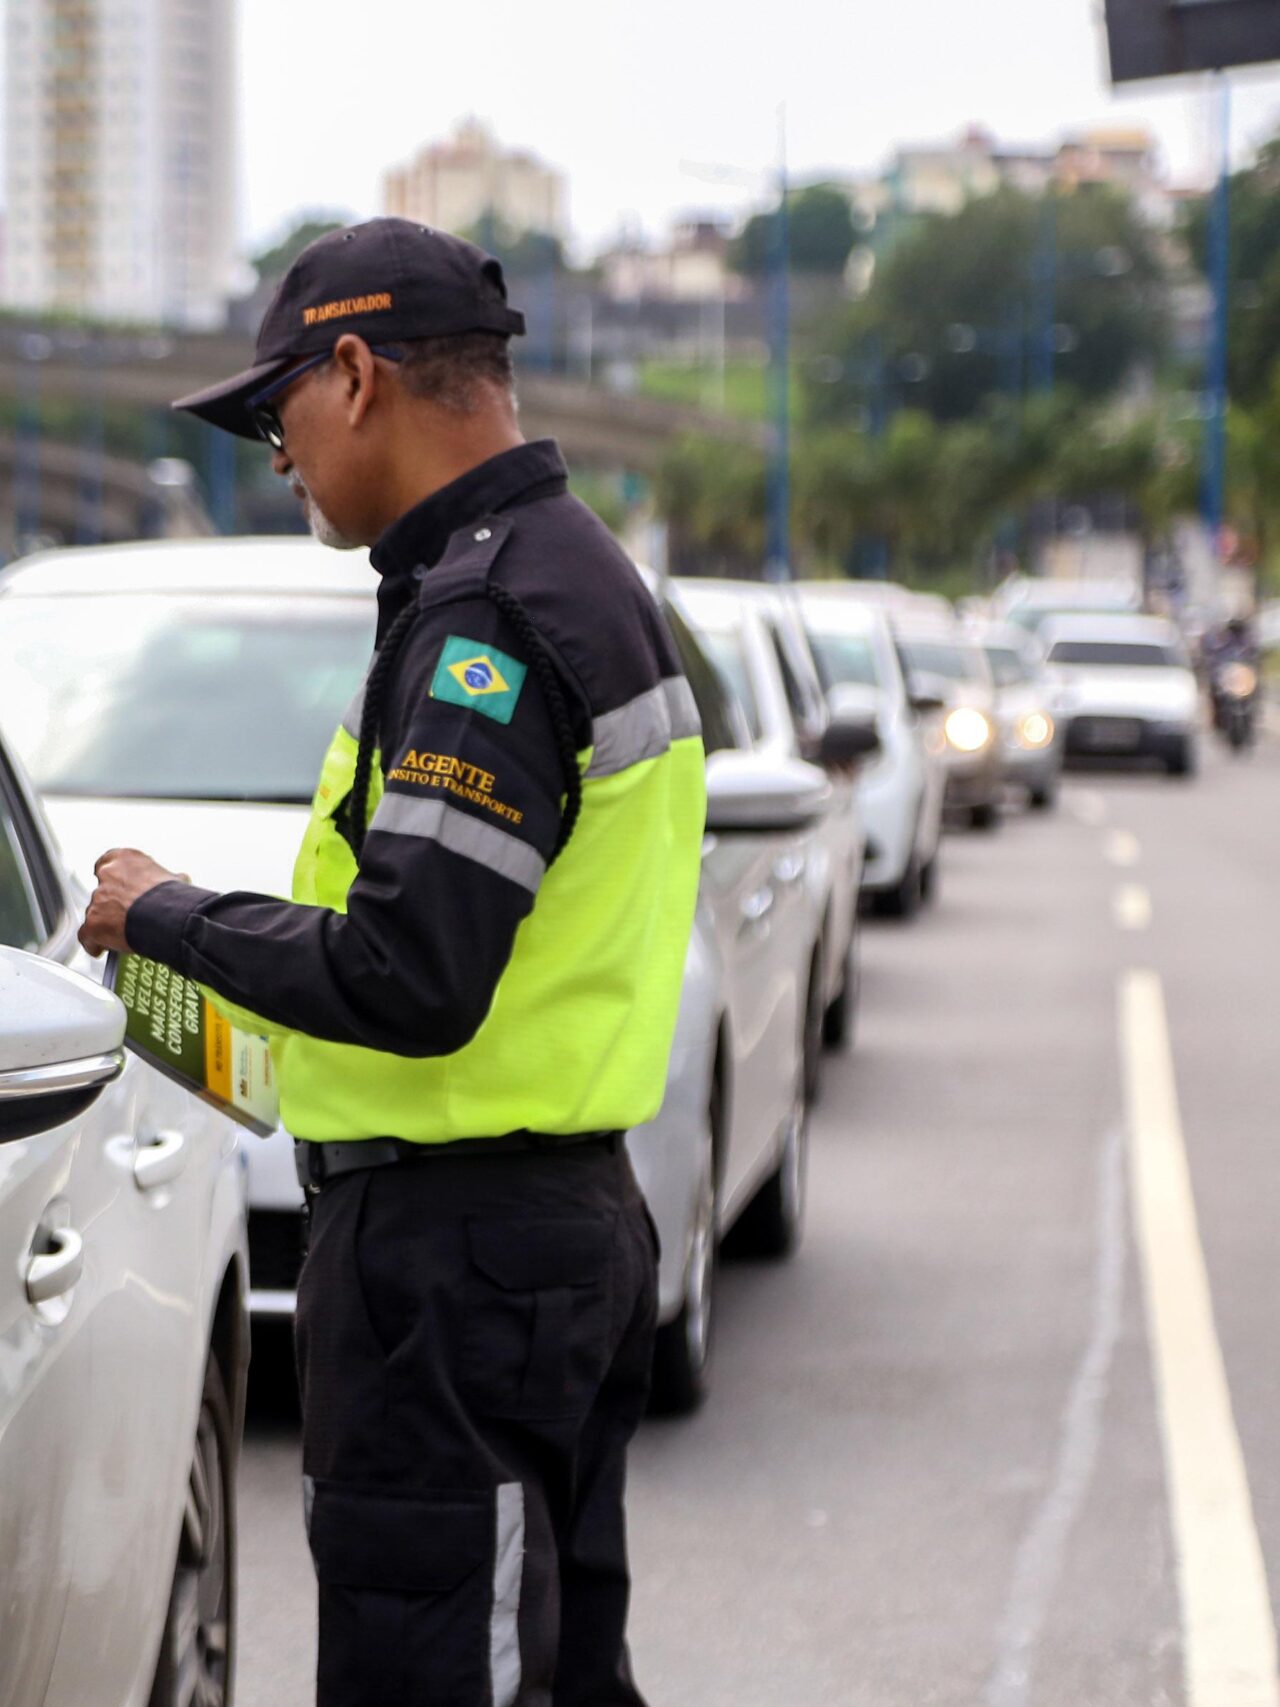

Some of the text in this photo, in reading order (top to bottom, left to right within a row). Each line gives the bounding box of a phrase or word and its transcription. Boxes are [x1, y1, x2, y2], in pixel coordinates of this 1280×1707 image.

[303, 292, 392, 326] TRANSALVADOR
[387, 767, 524, 825] NSITO E TRANSPORTE
[401, 749, 496, 793] AGENTE
[151, 963, 169, 1042] MAIS RIS
[167, 975, 184, 1055] CONSEQU
